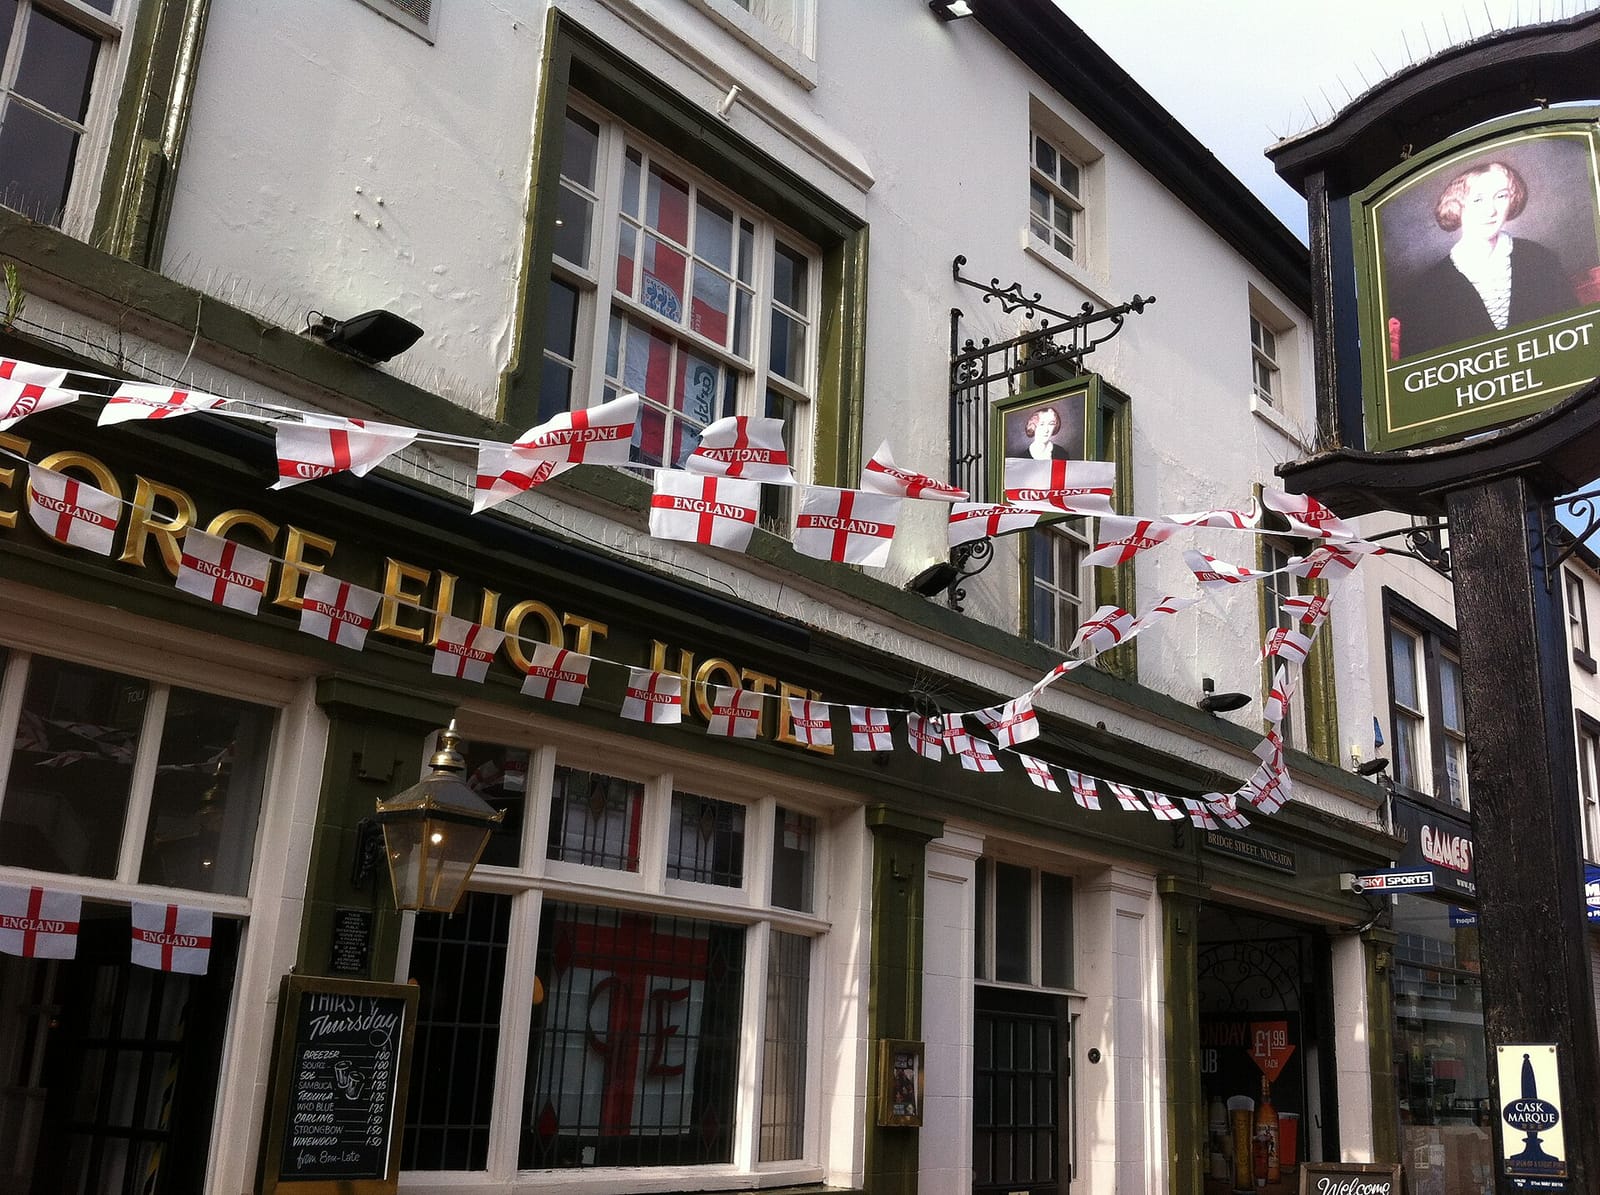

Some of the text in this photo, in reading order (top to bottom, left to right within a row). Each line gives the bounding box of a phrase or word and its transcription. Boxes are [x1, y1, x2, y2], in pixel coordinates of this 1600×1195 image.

[1404, 323, 1593, 393] GEORGE ELIOT
[1456, 368, 1543, 408] HOTEL
[534, 426, 619, 447] ENGLAND
[701, 447, 770, 463] ENGLAND
[1018, 488, 1091, 500] ENGLAND
[37, 494, 102, 525] ENGLAND
[673, 497, 745, 521] ENGLAND
[966, 507, 1032, 518] ENGLAND
[0, 432, 336, 609] ORE
[809, 514, 880, 535] ENGLAND
[196, 560, 255, 588] ENGLAND
[315, 602, 362, 626] ENGLAND
[448, 643, 487, 660] ENGLAND
[535, 666, 577, 682] ENGLAND
[634, 689, 672, 704] ENGLAND
[719, 707, 752, 718] ENGLAND
[795, 719, 824, 729] ENGLAND
[859, 725, 884, 734] ENGLAND
[910, 728, 936, 744] NGLAND
[1207, 832, 1234, 850] BRIDGE
[1260, 848, 1293, 866] NUNEATON
[1420, 825, 1470, 873] GAMES
[1364, 875, 1429, 887] SKY SPORTS
[2, 916, 65, 933] ENGLAND
[143, 930, 198, 947] ENGLAND
[309, 993, 378, 1015] THIRSTY
[309, 1008, 398, 1045] Thursday
[1200, 1022, 1246, 1045] ONDAY
[1255, 1030, 1286, 1057] £1.99
[302, 1050, 340, 1059] BREEZER
[1201, 1049, 1218, 1073] UB
[299, 1071, 316, 1080] SOL
[298, 1081, 333, 1090] SAMBUCA
[298, 1090, 334, 1101] TEQUILA
[296, 1102, 315, 1111] WKD
[316, 1102, 335, 1112] BLUE
[1515, 1102, 1544, 1113] CASK
[293, 1113, 335, 1124] CARLING
[1507, 1113, 1556, 1124] MARQUE
[293, 1125, 344, 1135] STRONGBOW
[297, 1149, 317, 1170] from
[1317, 1177, 1391, 1195] Welcome
